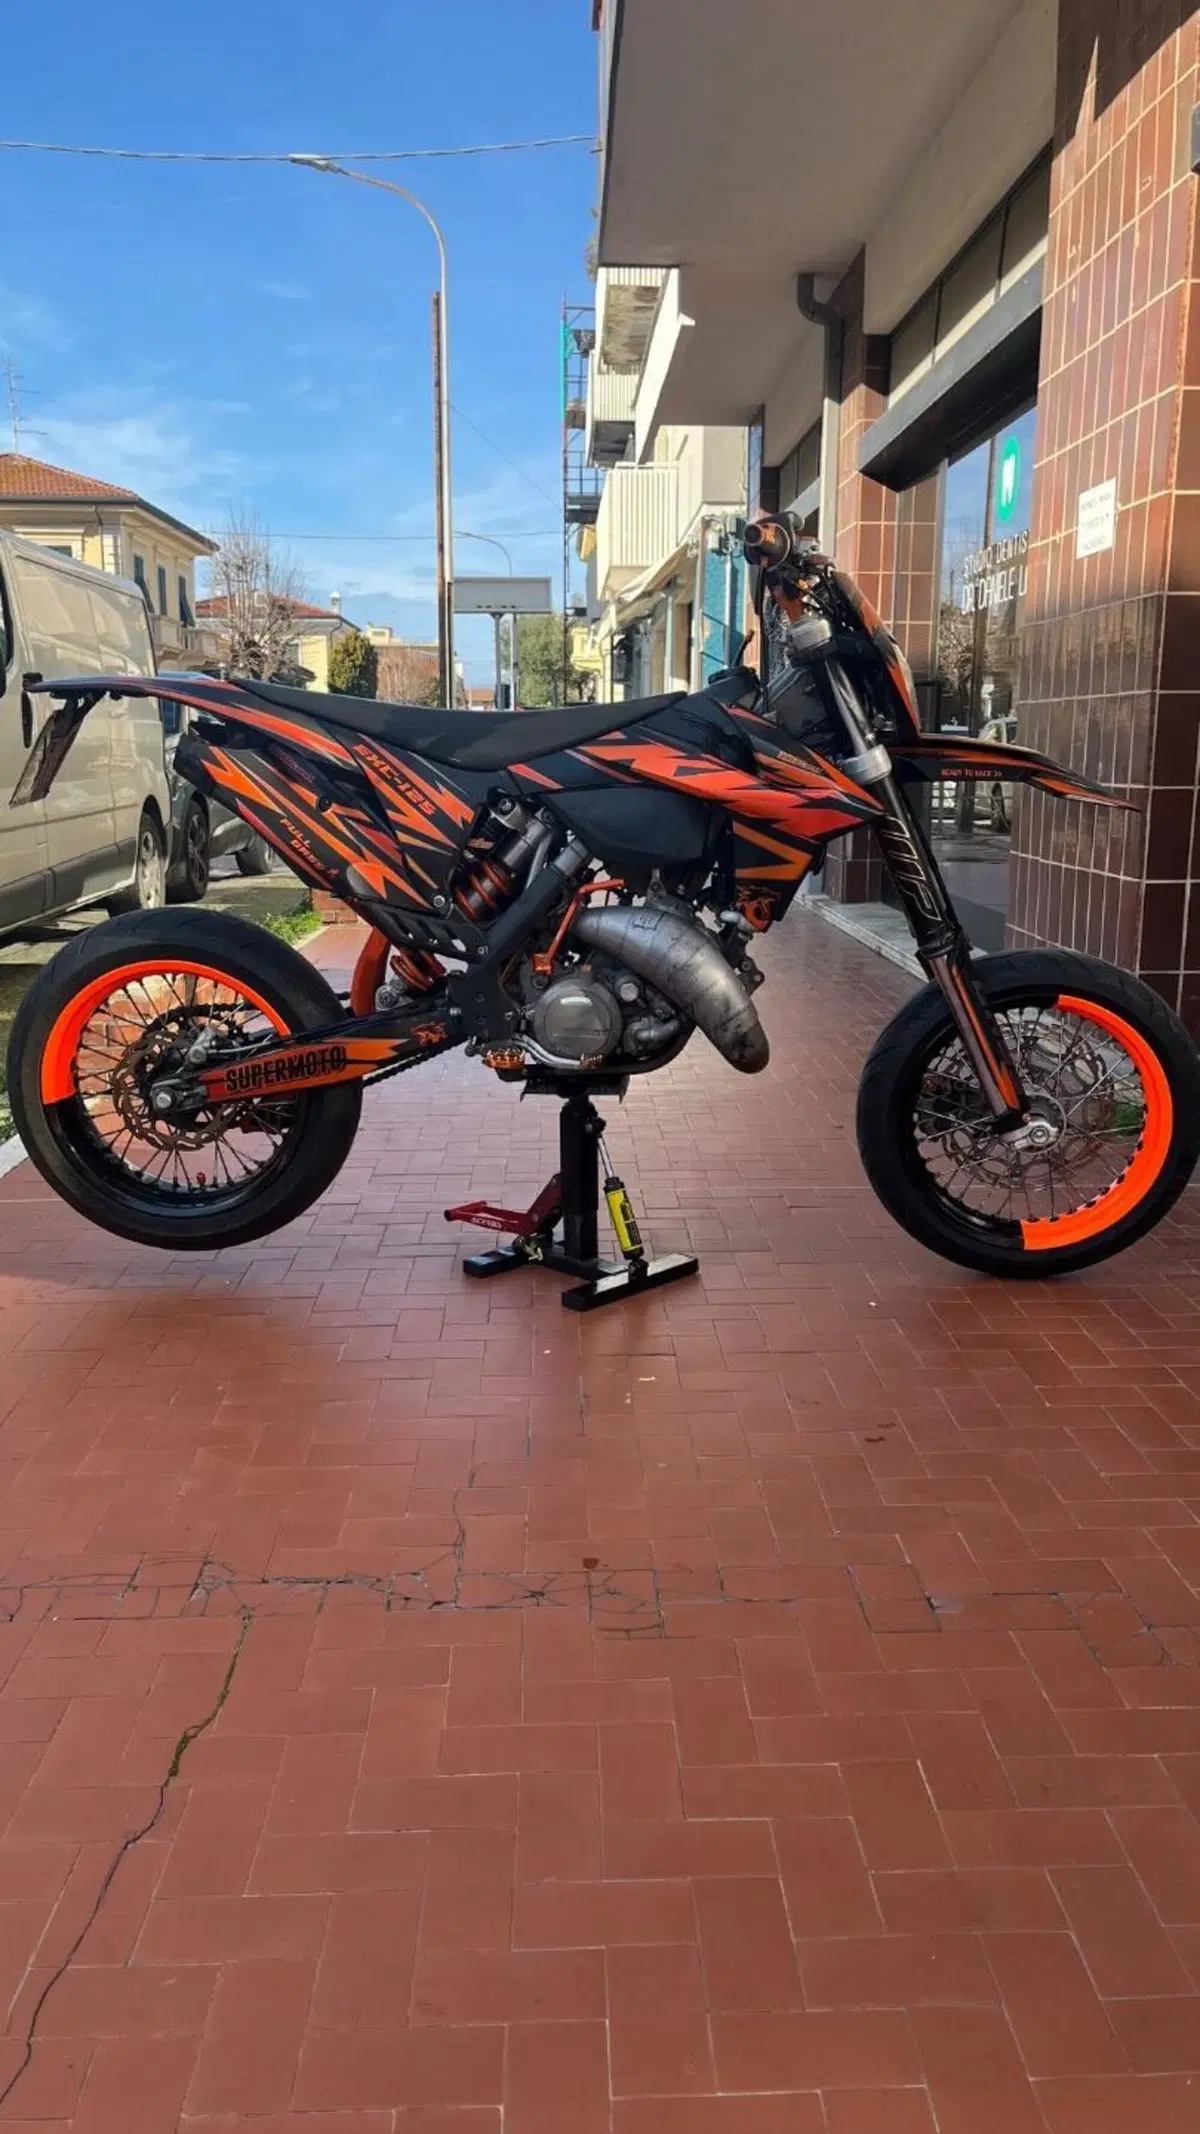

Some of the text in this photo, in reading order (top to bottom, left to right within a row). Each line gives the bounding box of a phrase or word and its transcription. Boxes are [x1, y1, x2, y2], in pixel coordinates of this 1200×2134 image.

[964, 546, 993, 579] STUDIO
[979, 567, 1016, 610] DANIELE
[280, 817, 312, 849] FULL
[224, 1045, 347, 1092] SUPERMOTO
